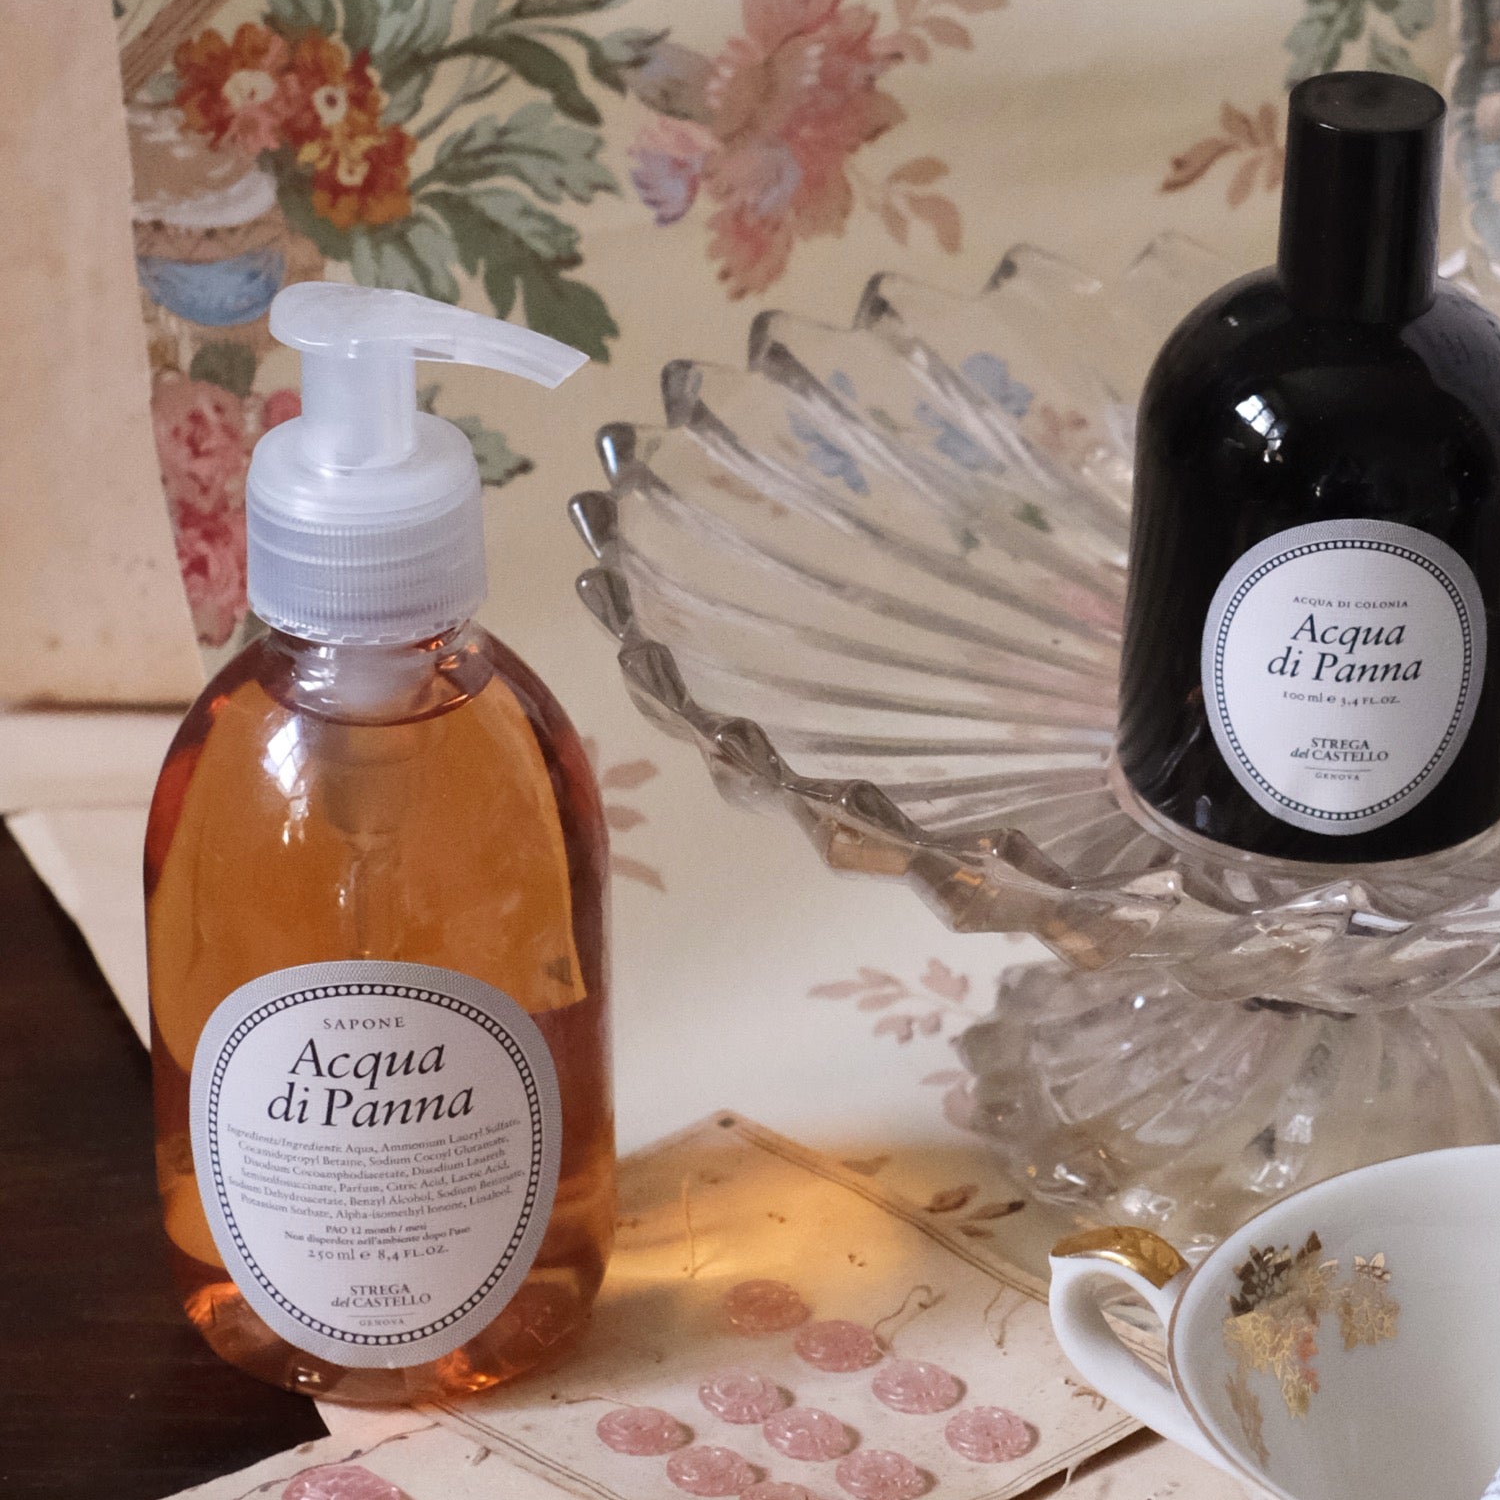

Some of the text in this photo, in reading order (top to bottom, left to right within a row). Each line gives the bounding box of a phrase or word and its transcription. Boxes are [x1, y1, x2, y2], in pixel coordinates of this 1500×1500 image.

[1293, 596, 1333, 608] ACQUA
[1355, 601, 1408, 609] COLONIA
[1291, 613, 1406, 654] Acqua
[1267, 646, 1423, 683] di Panna
[1283, 691, 1305, 701] 100
[1308, 692, 1322, 703] ml
[1311, 737, 1370, 751] STREGA
[1290, 748, 1389, 763] del CASTELLO
[1315, 772, 1360, 782] GENOVA
[323, 1017, 406, 1031] SAPONE
[288, 1038, 446, 1090] Acqua
[267, 1082, 475, 1128] di Panna
[307, 1250, 334, 1261] 250
[337, 1249, 355, 1261] ml
[350, 1284, 410, 1296] STREGA
[331, 1293, 432, 1308] del CASTELLO
